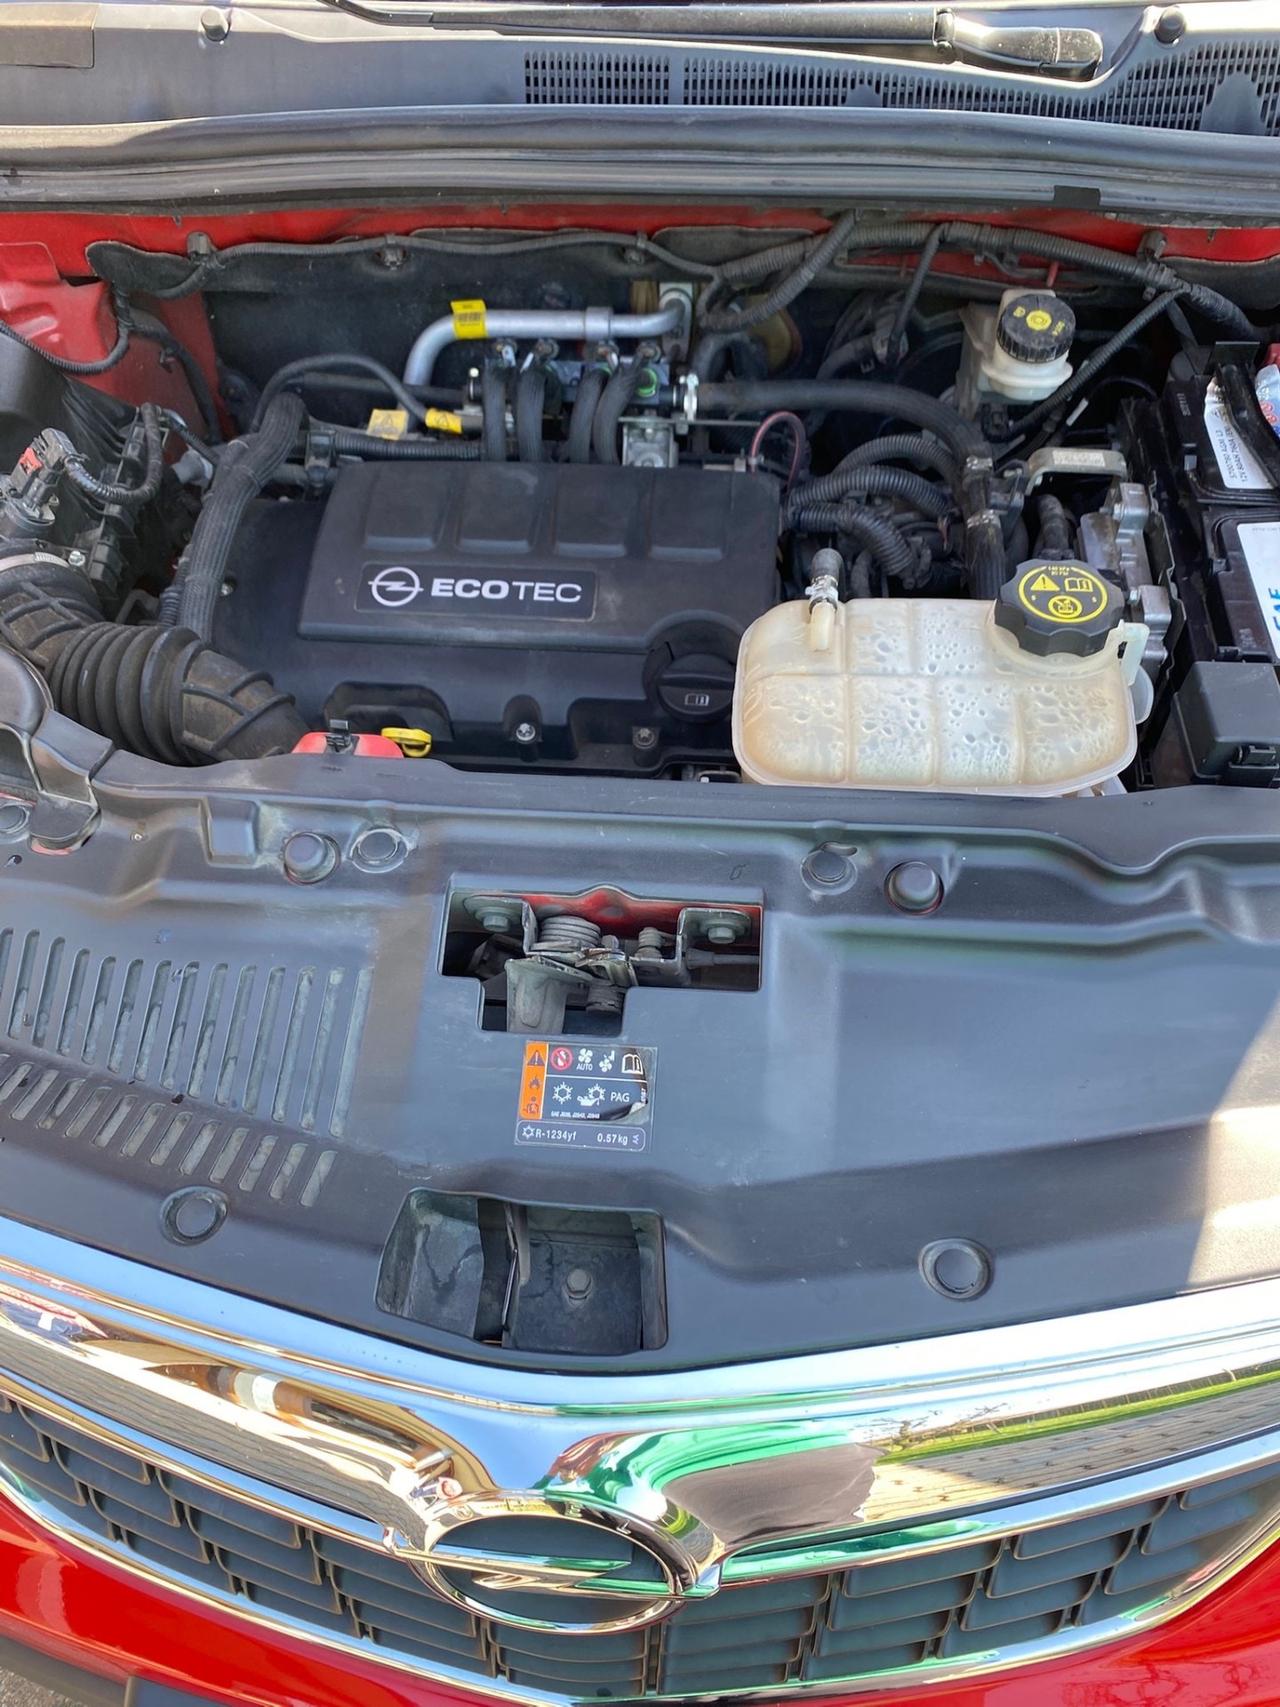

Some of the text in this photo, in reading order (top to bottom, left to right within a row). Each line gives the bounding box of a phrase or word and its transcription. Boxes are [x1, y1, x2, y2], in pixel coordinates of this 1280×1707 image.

[431, 578, 582, 603] ECOTEC
[576, 1063, 593, 1071] AUTO
[610, 1092, 630, 1102] PAG
[536, 1130, 577, 1142] R-1234yf
